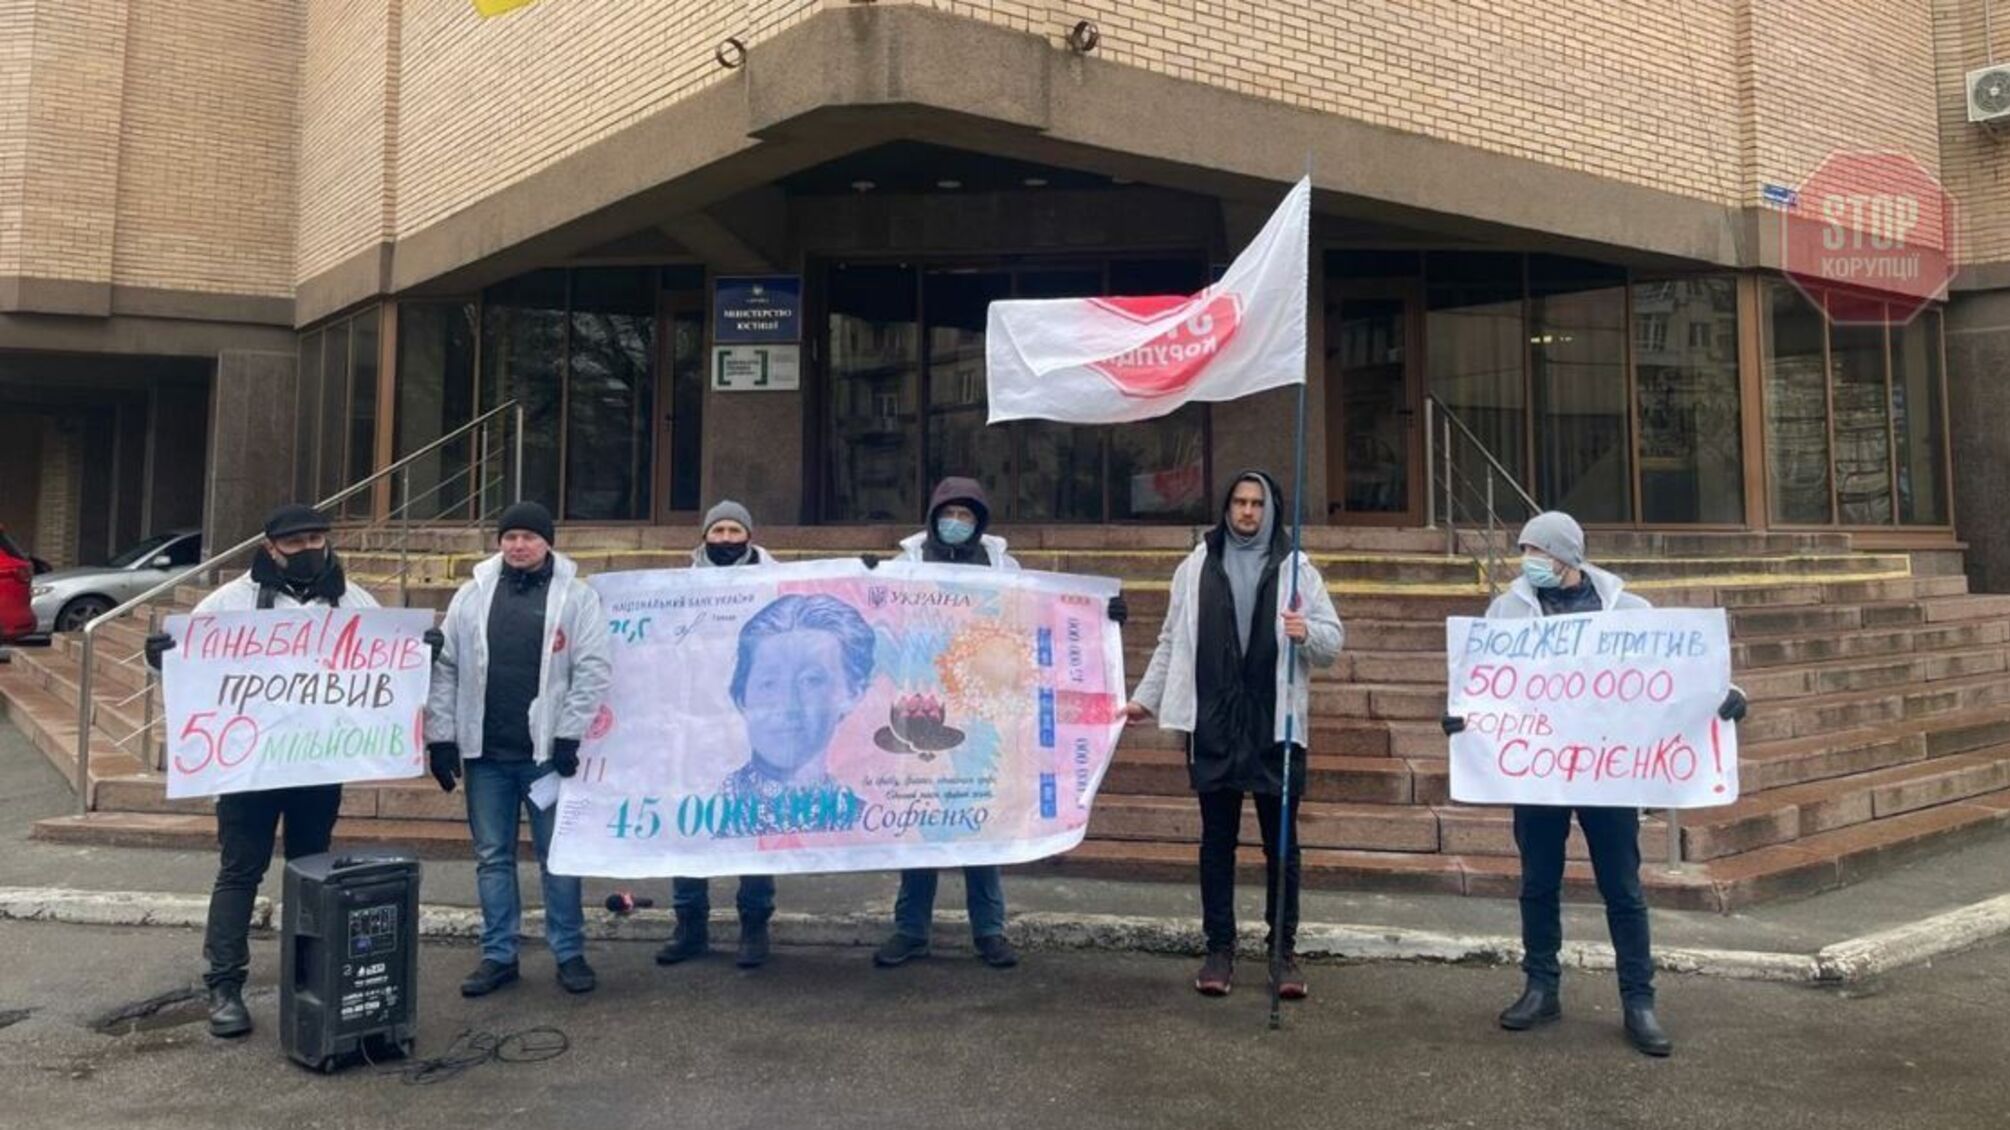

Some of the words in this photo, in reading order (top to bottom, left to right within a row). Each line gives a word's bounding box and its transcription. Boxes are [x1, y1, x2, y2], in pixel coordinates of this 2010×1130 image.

[724, 309, 792, 318] МІНІСТЕРСТВО
[737, 321, 779, 330] ЮСТИЦІЇ
[890, 591, 971, 607] УКРАЇНА
[1464, 665, 1516, 699] 50
[174, 711, 259, 775] 50
[607, 796, 660, 838] 45
[862, 799, 989, 838] Софієнко
